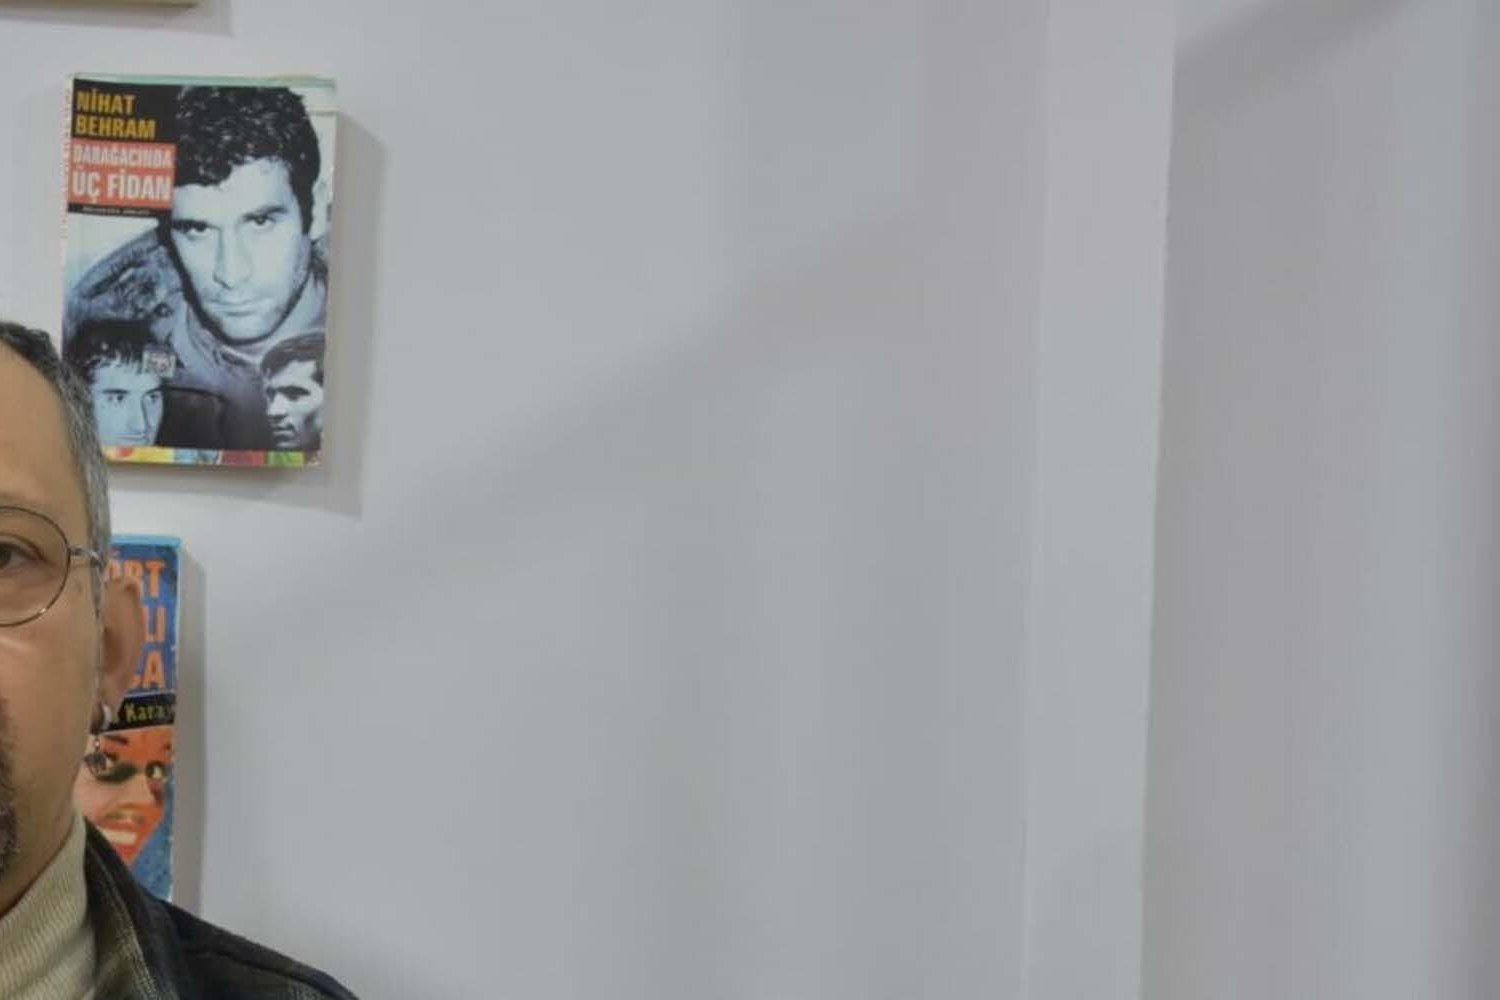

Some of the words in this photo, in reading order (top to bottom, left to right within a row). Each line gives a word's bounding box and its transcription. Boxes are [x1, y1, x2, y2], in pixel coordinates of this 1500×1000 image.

[77, 88, 135, 115] NİHAT
[76, 114, 156, 139] BEHRAM
[72, 165, 100, 204] ÜÇ
[107, 168, 172, 202] FİDAN
